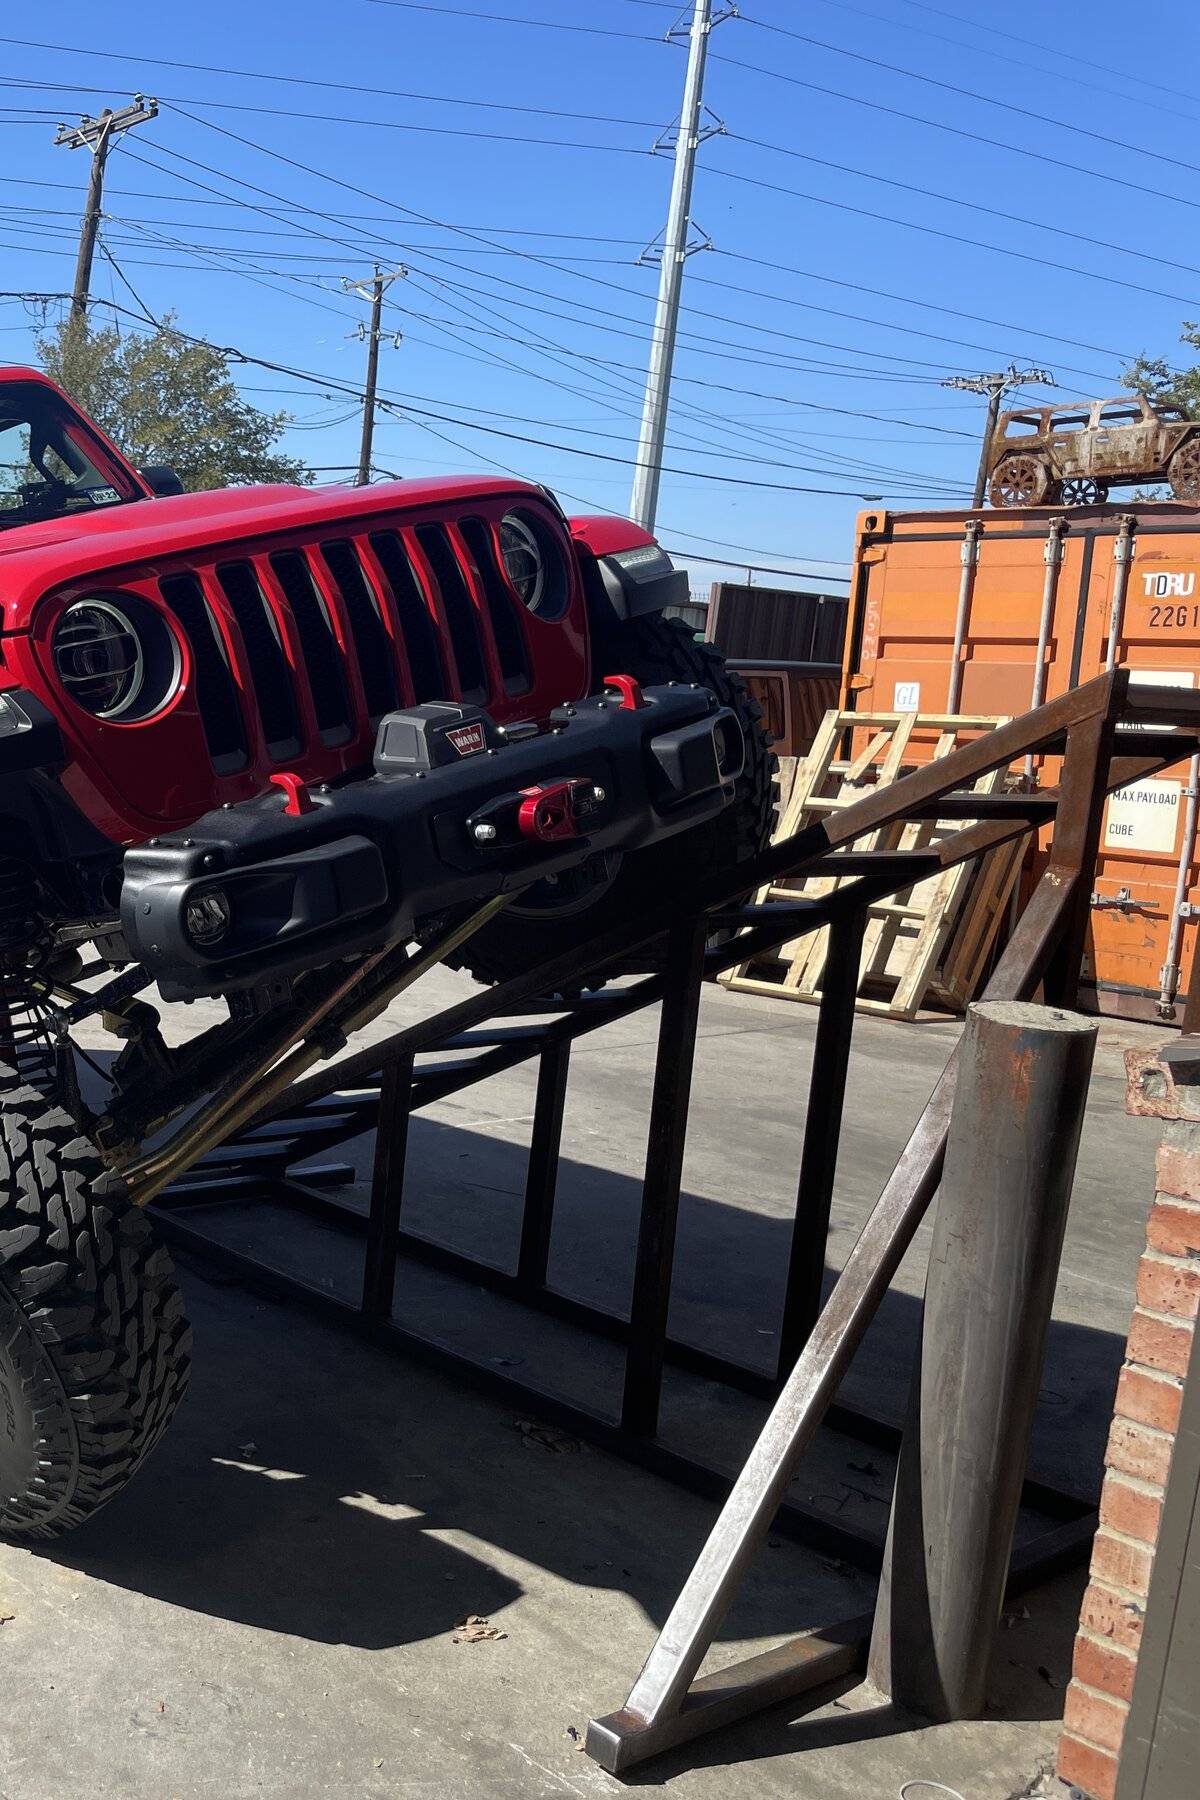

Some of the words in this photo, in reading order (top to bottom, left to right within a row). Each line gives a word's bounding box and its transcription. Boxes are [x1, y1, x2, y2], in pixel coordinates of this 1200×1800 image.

[1142, 572, 1195, 597] TDRU
[1149, 605, 1199, 627] 22G1
[896, 685, 917, 706] GL
[454, 732, 481, 748] WARN
[1109, 823, 1134, 836] CUBE
